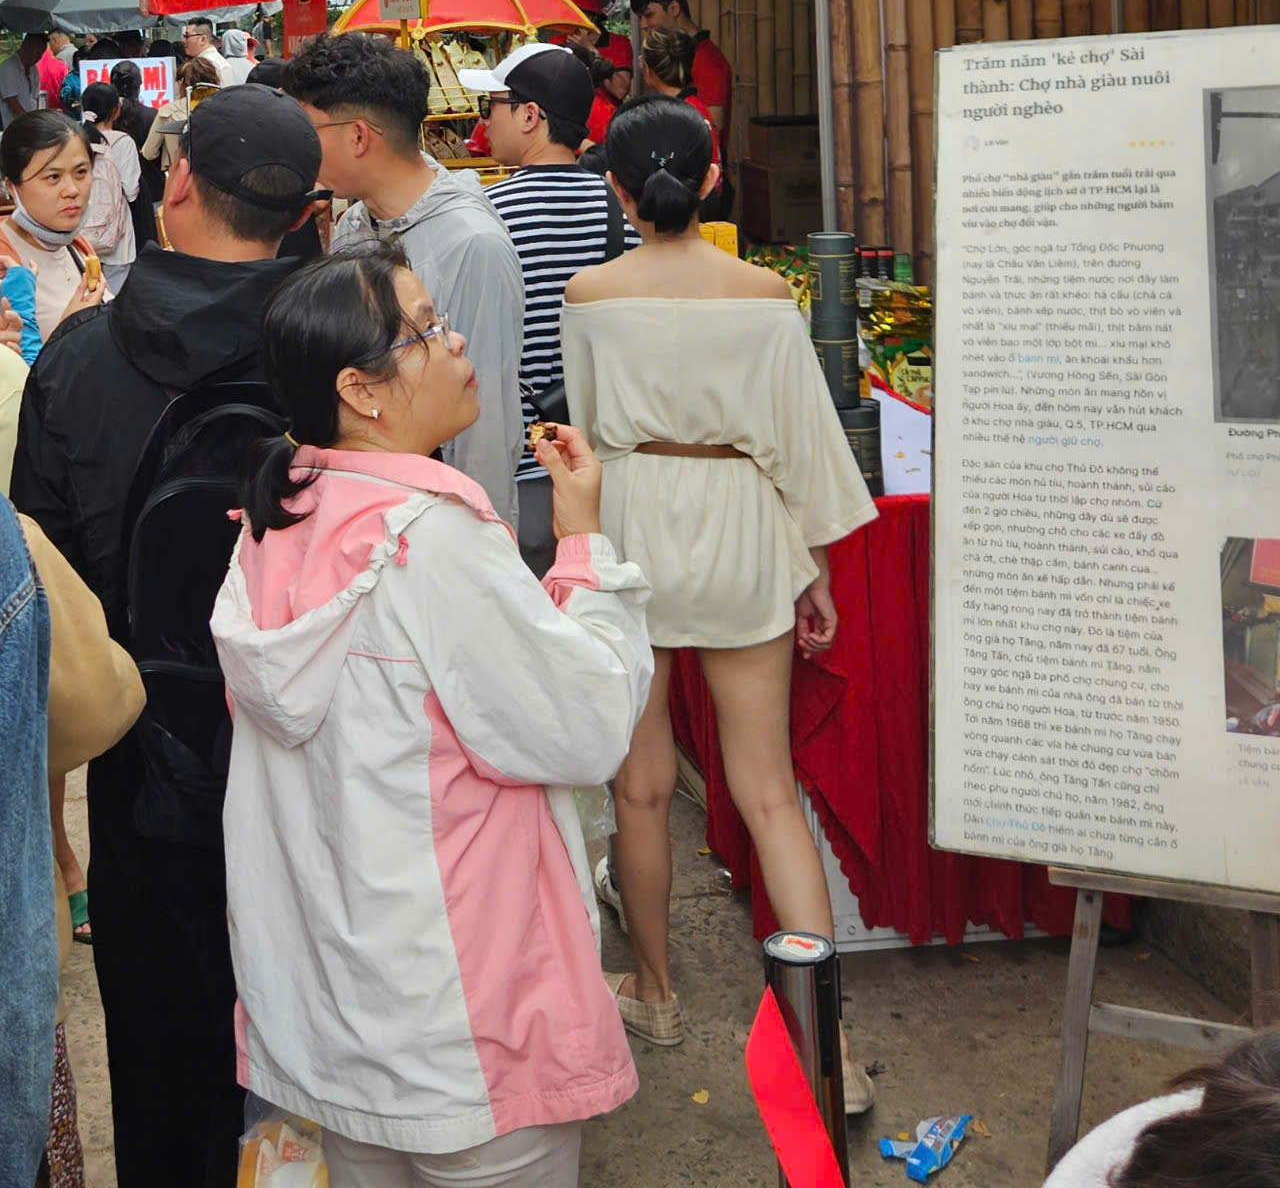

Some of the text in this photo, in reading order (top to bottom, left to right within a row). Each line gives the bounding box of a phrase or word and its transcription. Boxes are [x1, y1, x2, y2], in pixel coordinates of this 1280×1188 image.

[963, 57, 1005, 70] Trăm
[1010, 54, 1046, 68] năm
[1119, 47, 1144, 61] Sài
[143, 61, 167, 90] MÌ
[963, 70, 1170, 94] thành: Chợ nhà giàu nuôi
[962, 101, 1063, 121] người nghèo
